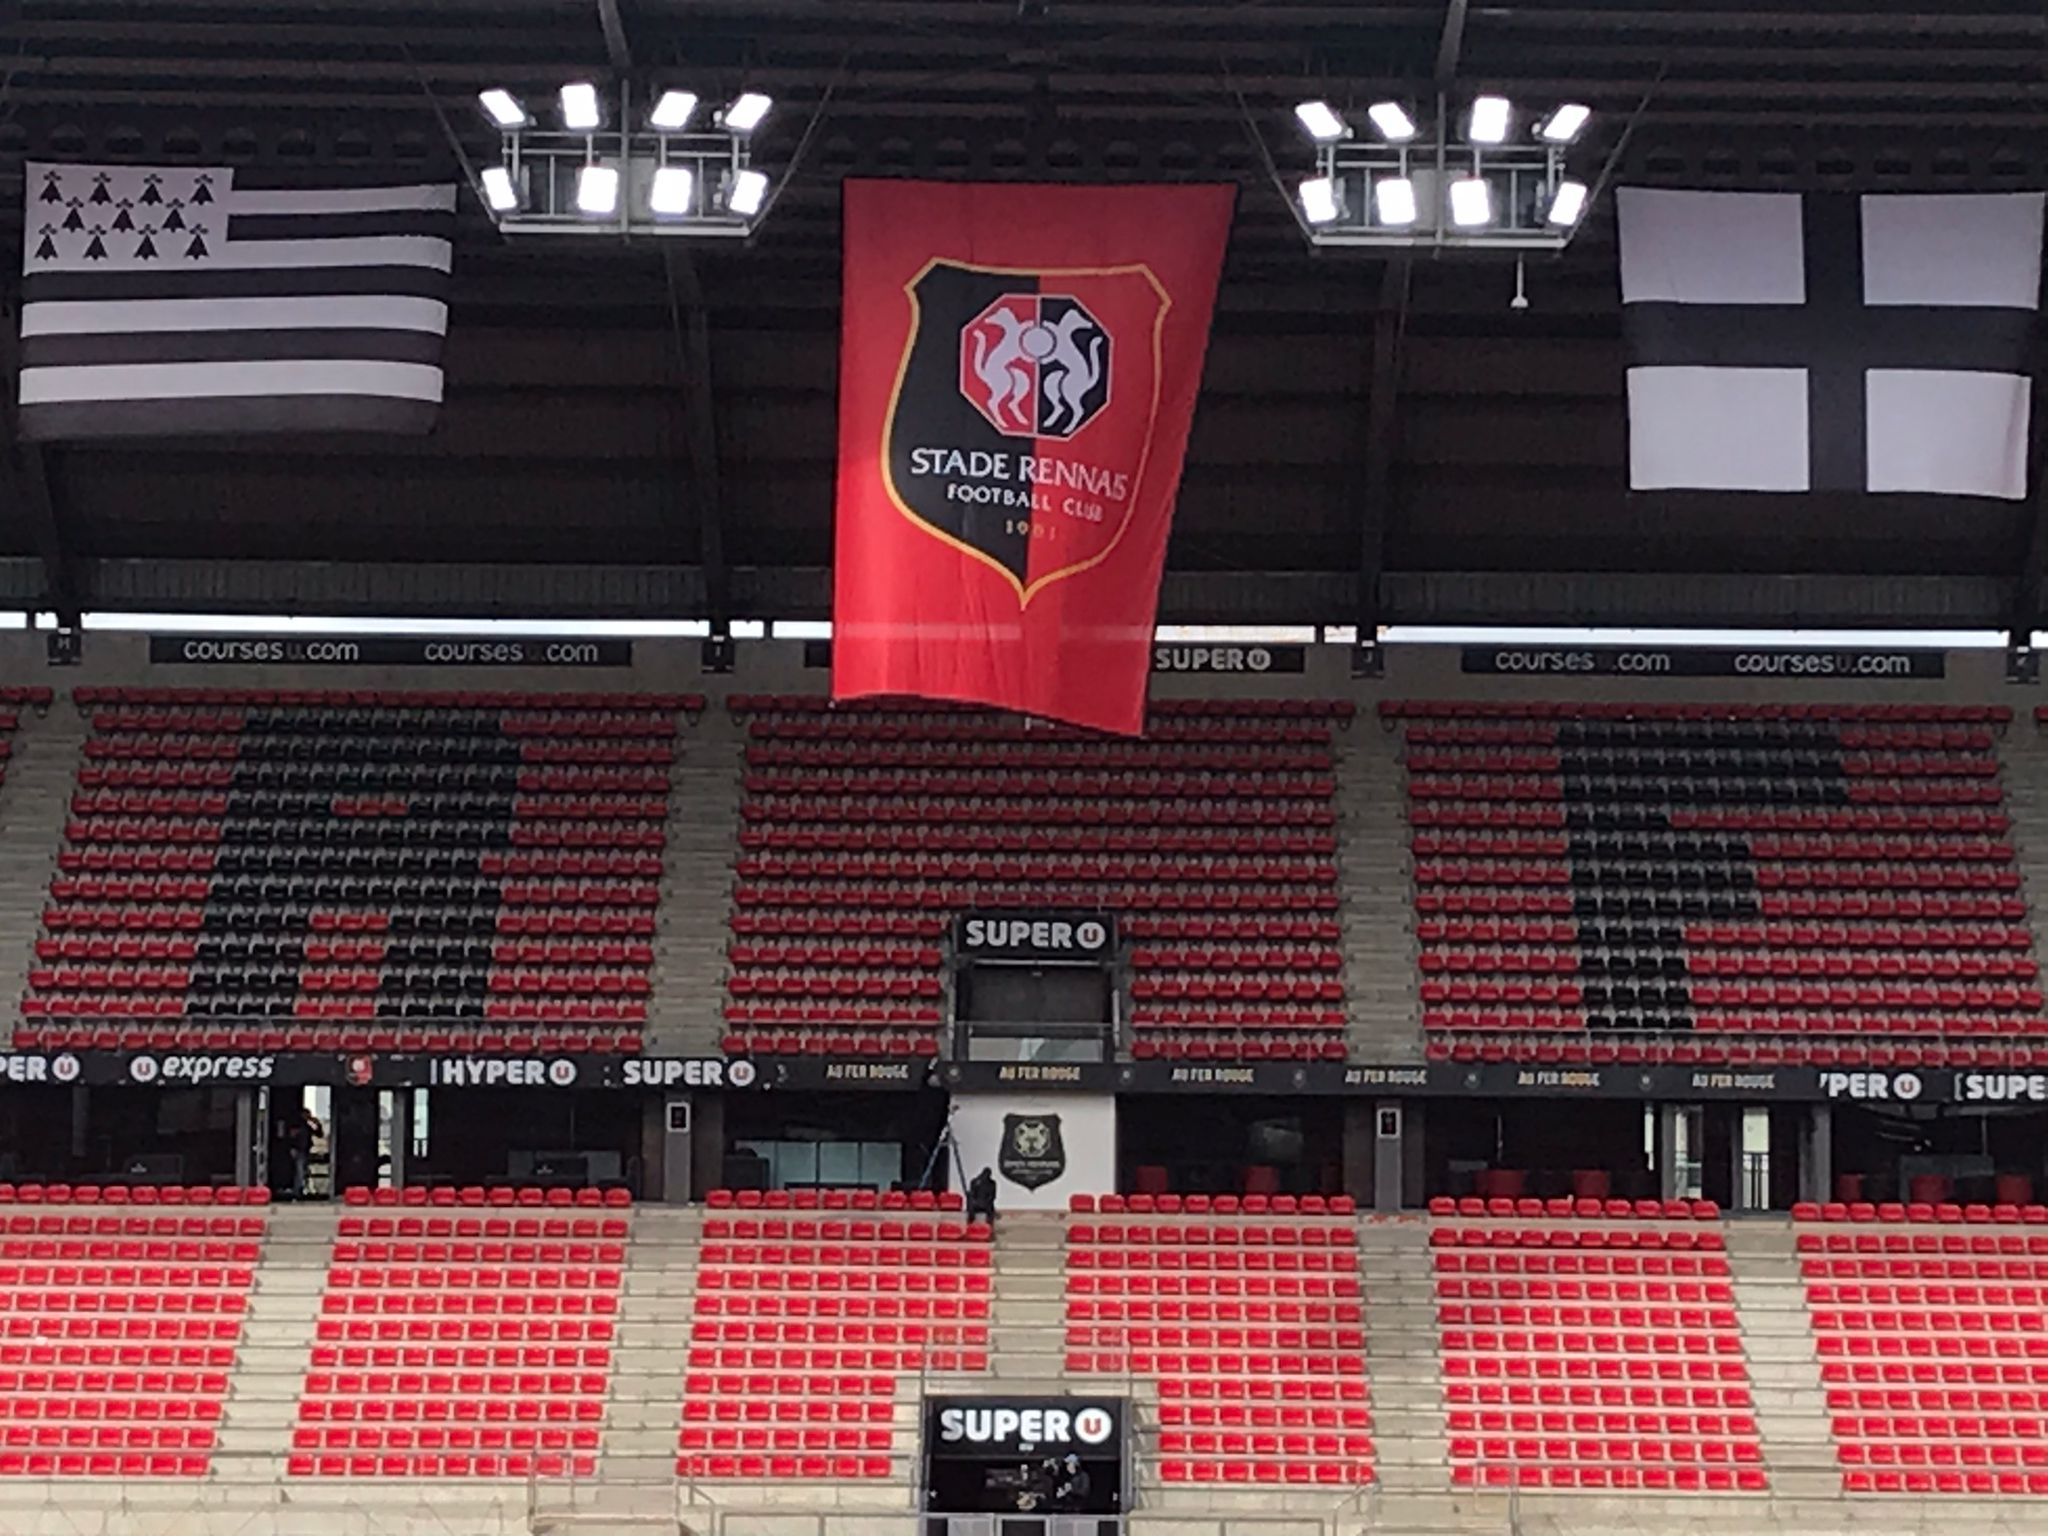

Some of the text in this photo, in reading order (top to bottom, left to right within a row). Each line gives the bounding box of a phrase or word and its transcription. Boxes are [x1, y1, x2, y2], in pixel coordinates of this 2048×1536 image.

[911, 447, 1129, 502] STADE RENNAIS
[947, 483, 1104, 523] FOOTBALL CLUB
[1155, 648, 1244, 670] SUPER
[965, 919, 1073, 949] SUPER
[162, 1055, 275, 1085] express
[442, 1058, 546, 1087] HYPER
[623, 1060, 723, 1086] SUPER
[940, 1408, 1071, 1443] SUPER
